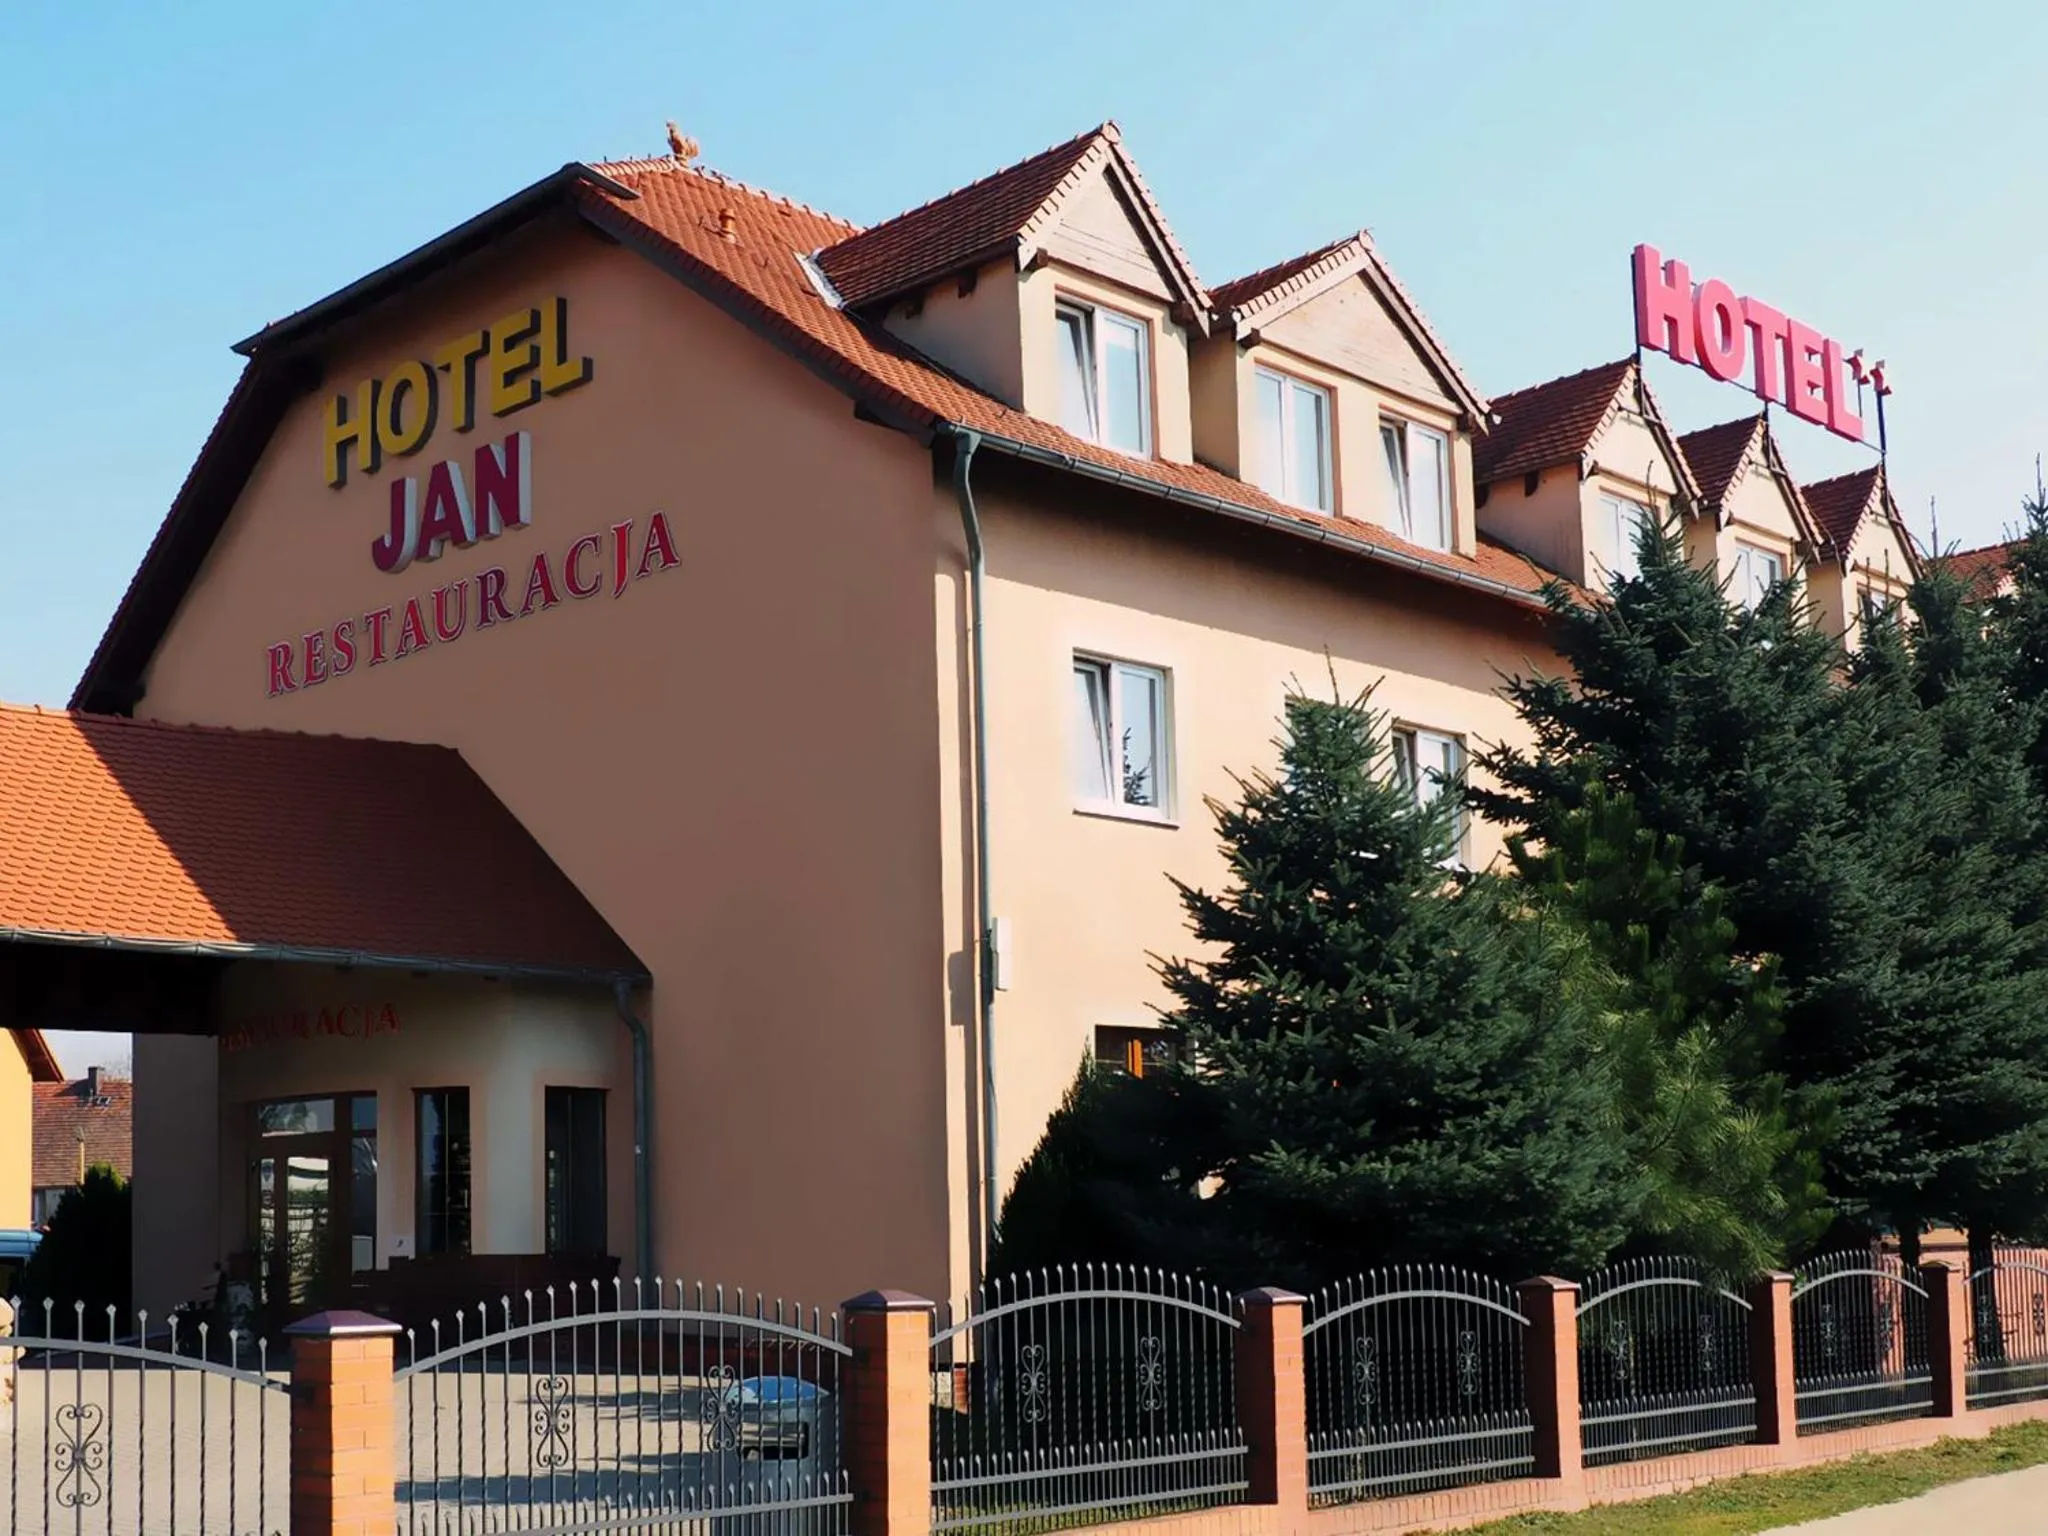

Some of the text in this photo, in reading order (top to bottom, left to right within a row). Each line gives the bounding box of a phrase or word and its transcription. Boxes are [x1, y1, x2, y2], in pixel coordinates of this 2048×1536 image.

[323, 296, 593, 489] HOTEL
[1634, 243, 1863, 442] HOTEL
[372, 431, 531, 573] JAN
[266, 510, 681, 697] RESTAURACJA
